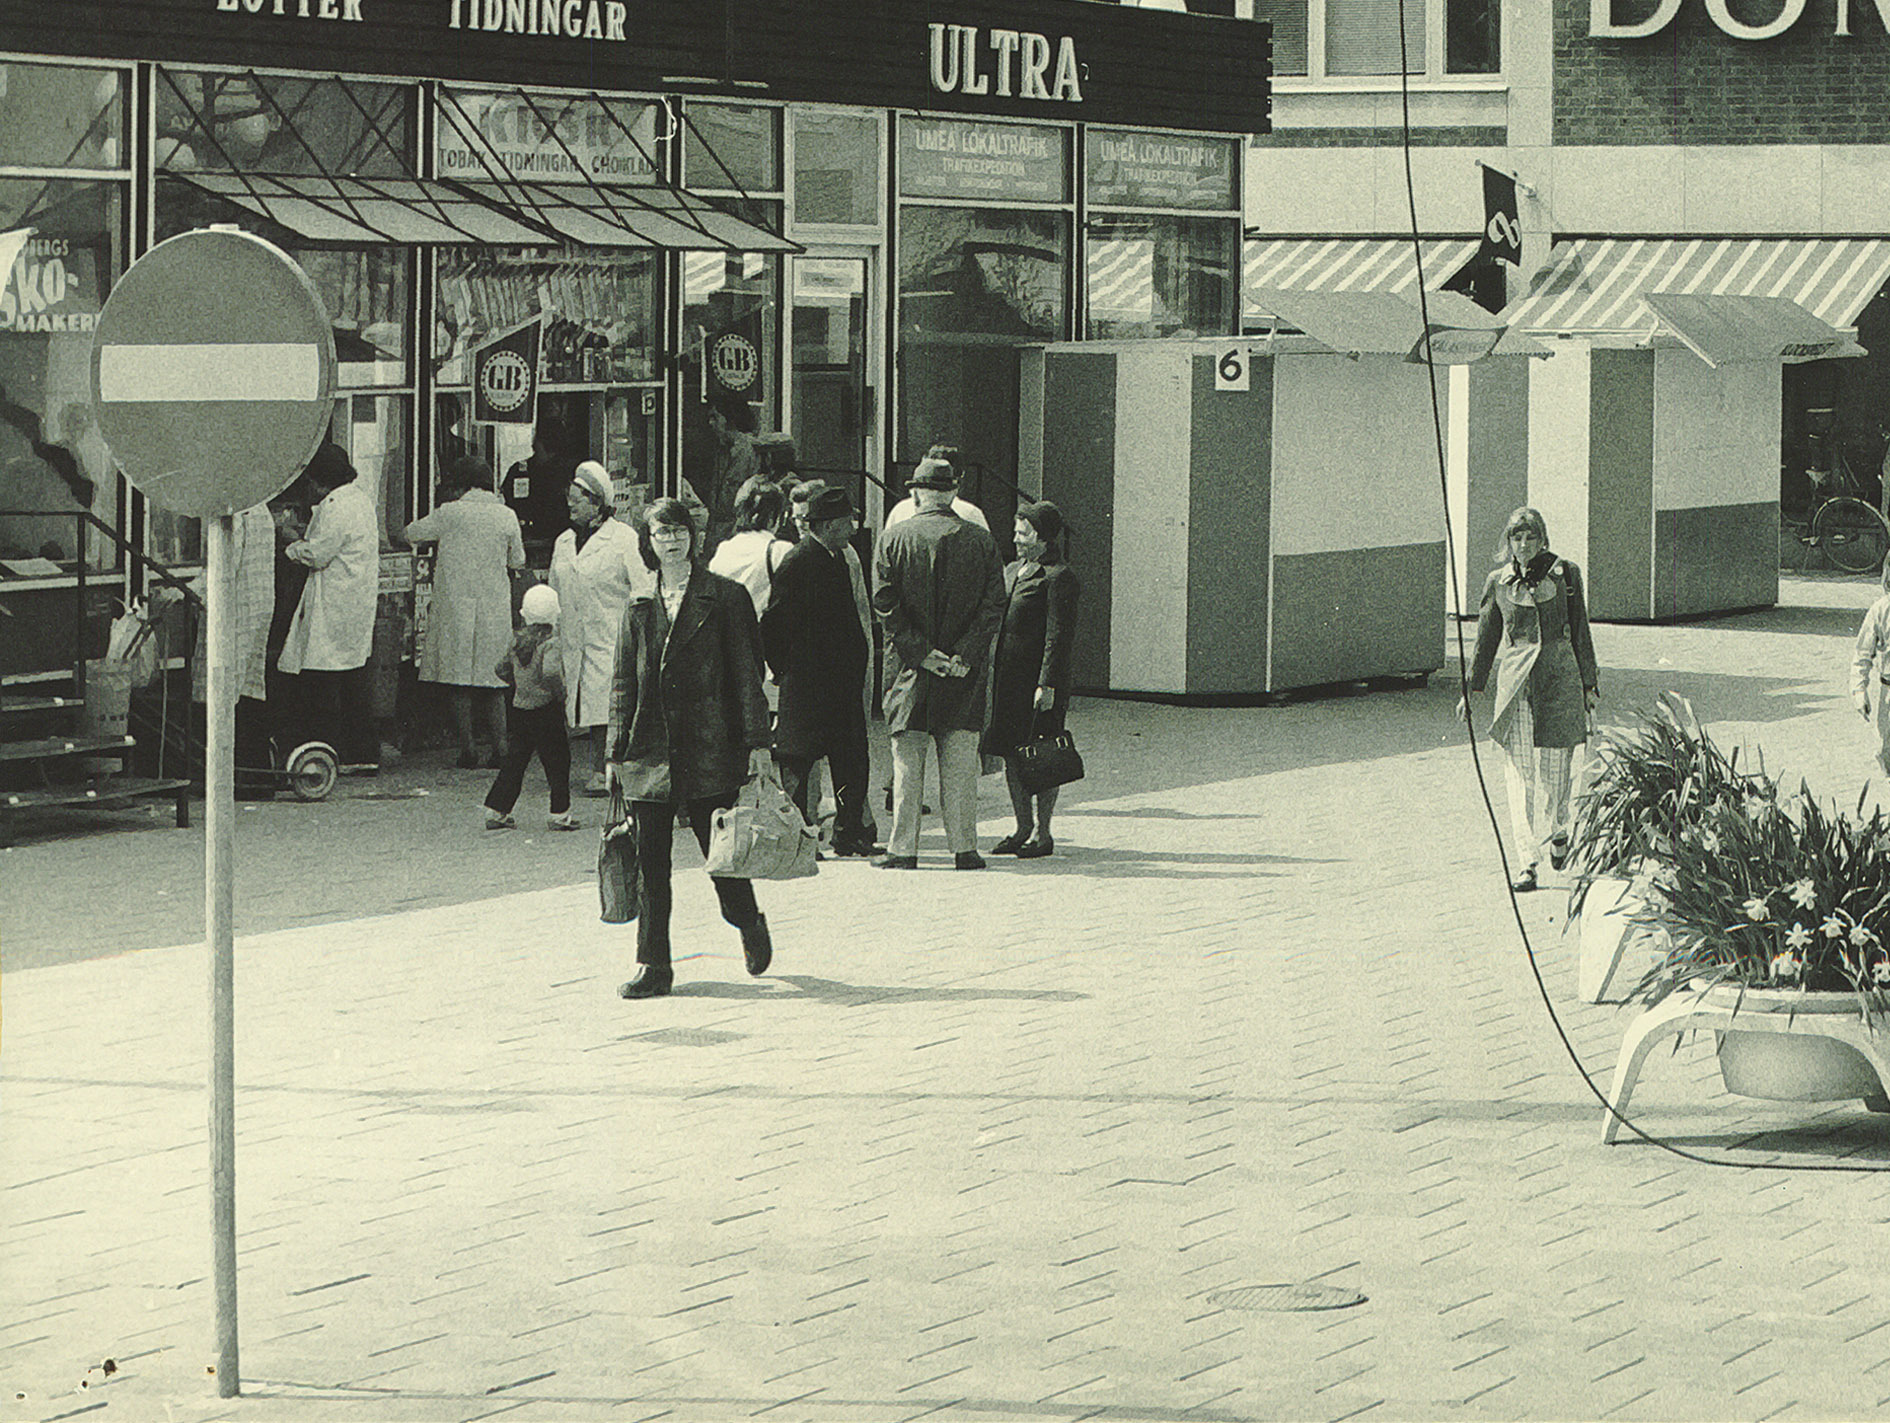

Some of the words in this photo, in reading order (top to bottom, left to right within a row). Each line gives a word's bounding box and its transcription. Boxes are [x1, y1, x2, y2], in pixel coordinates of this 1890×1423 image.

[928, 23, 1083, 102] ULTRA
[22, 238, 69, 256] BERGS
[718, 347, 751, 371] GB
[1219, 349, 1242, 382] 6
[488, 364, 522, 391] GB
